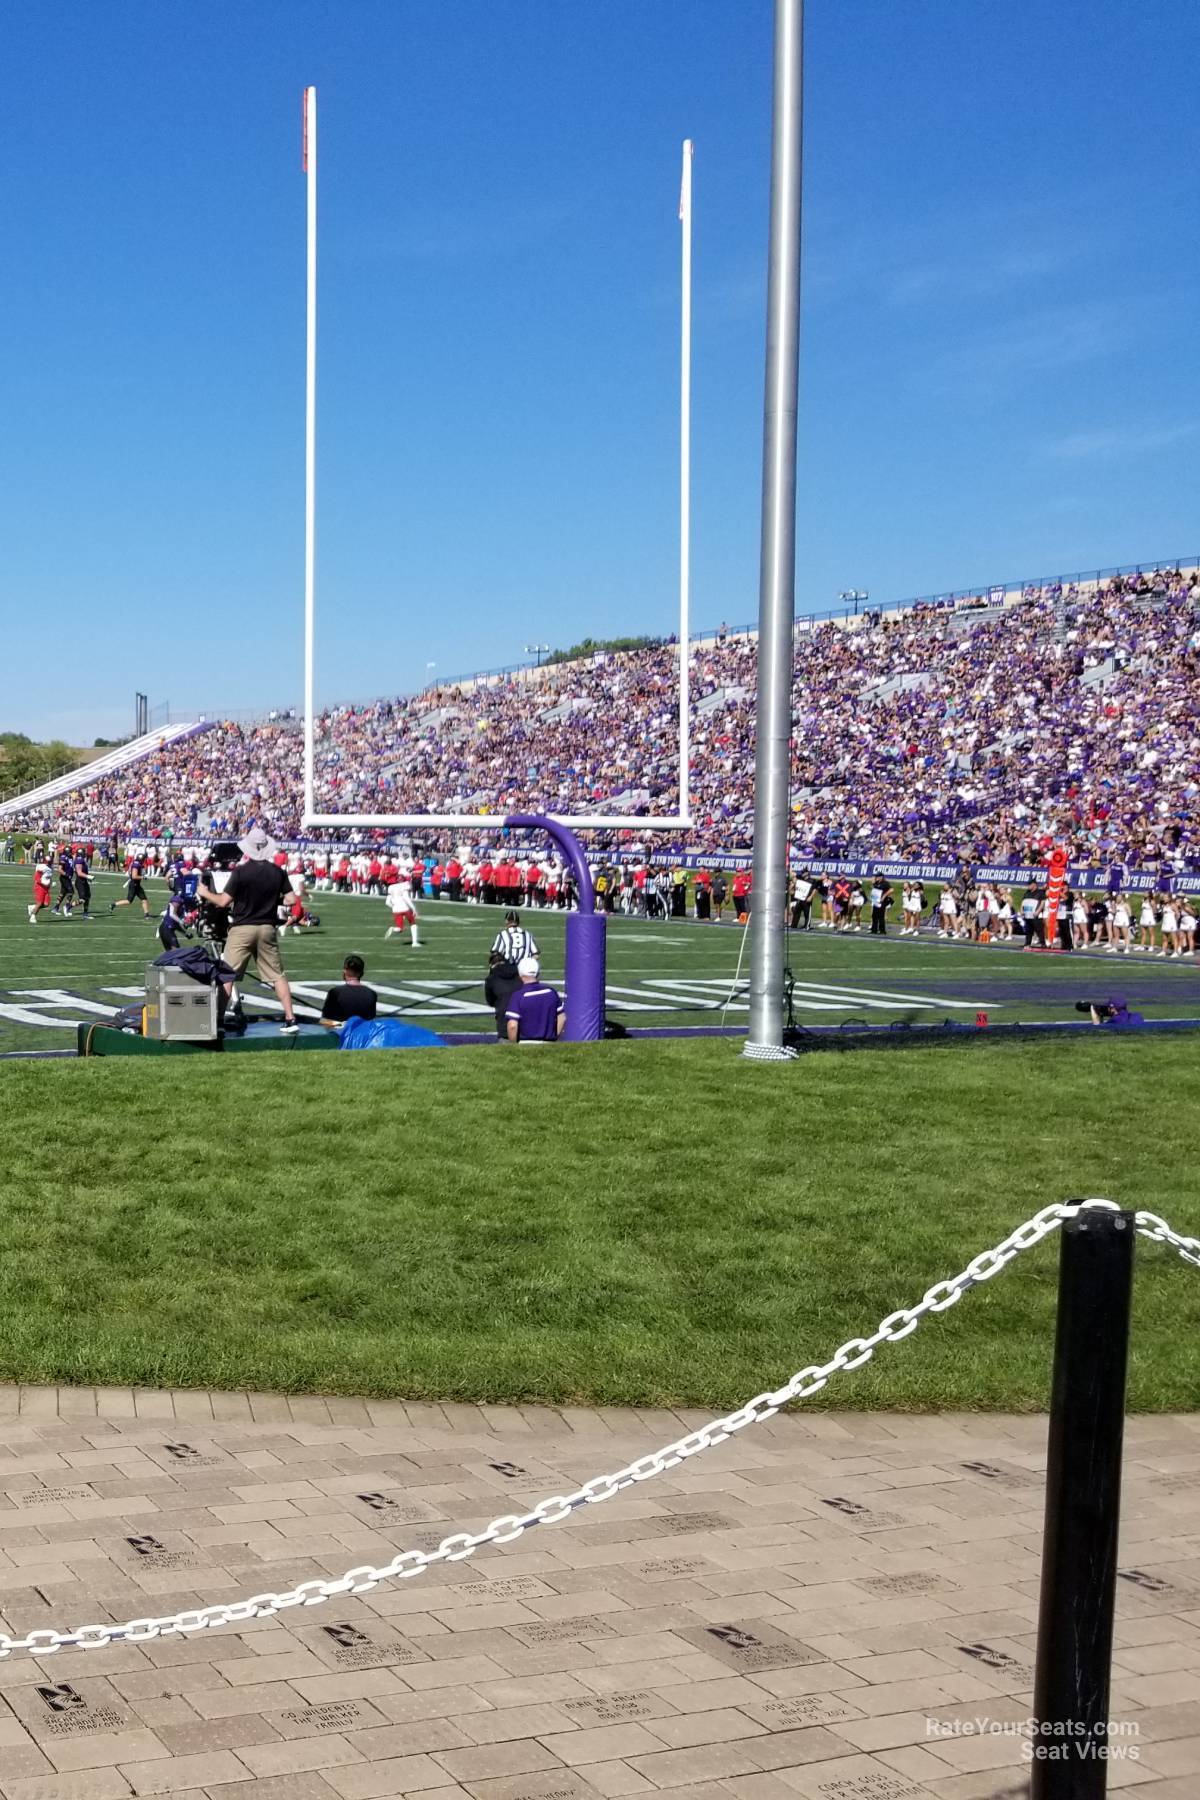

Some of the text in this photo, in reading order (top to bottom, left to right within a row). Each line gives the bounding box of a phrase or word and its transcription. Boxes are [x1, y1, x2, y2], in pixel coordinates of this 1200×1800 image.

[812, 862, 855, 874] BIG TEN TEAM
[860, 863, 868, 875] N
[873, 864, 957, 878] CHICAGO'S BIG TEN TEAM
[977, 868, 1015, 881] CHICAGO'S
[1016, 869, 1030, 881] BIG
[1032, 870, 1048, 883] TEN
[1078, 872, 1087, 886] N
[1138, 876, 1155, 889] BIG
[781, 1705, 821, 1716] MAGGIE
[294, 1710, 361, 1725] THE WALKER
[314, 1719, 353, 1730] FAMILY
[818, 1780, 856, 1792] COACH
[851, 1786, 875, 1795] THE
[876, 1780, 904, 1791] BEST
